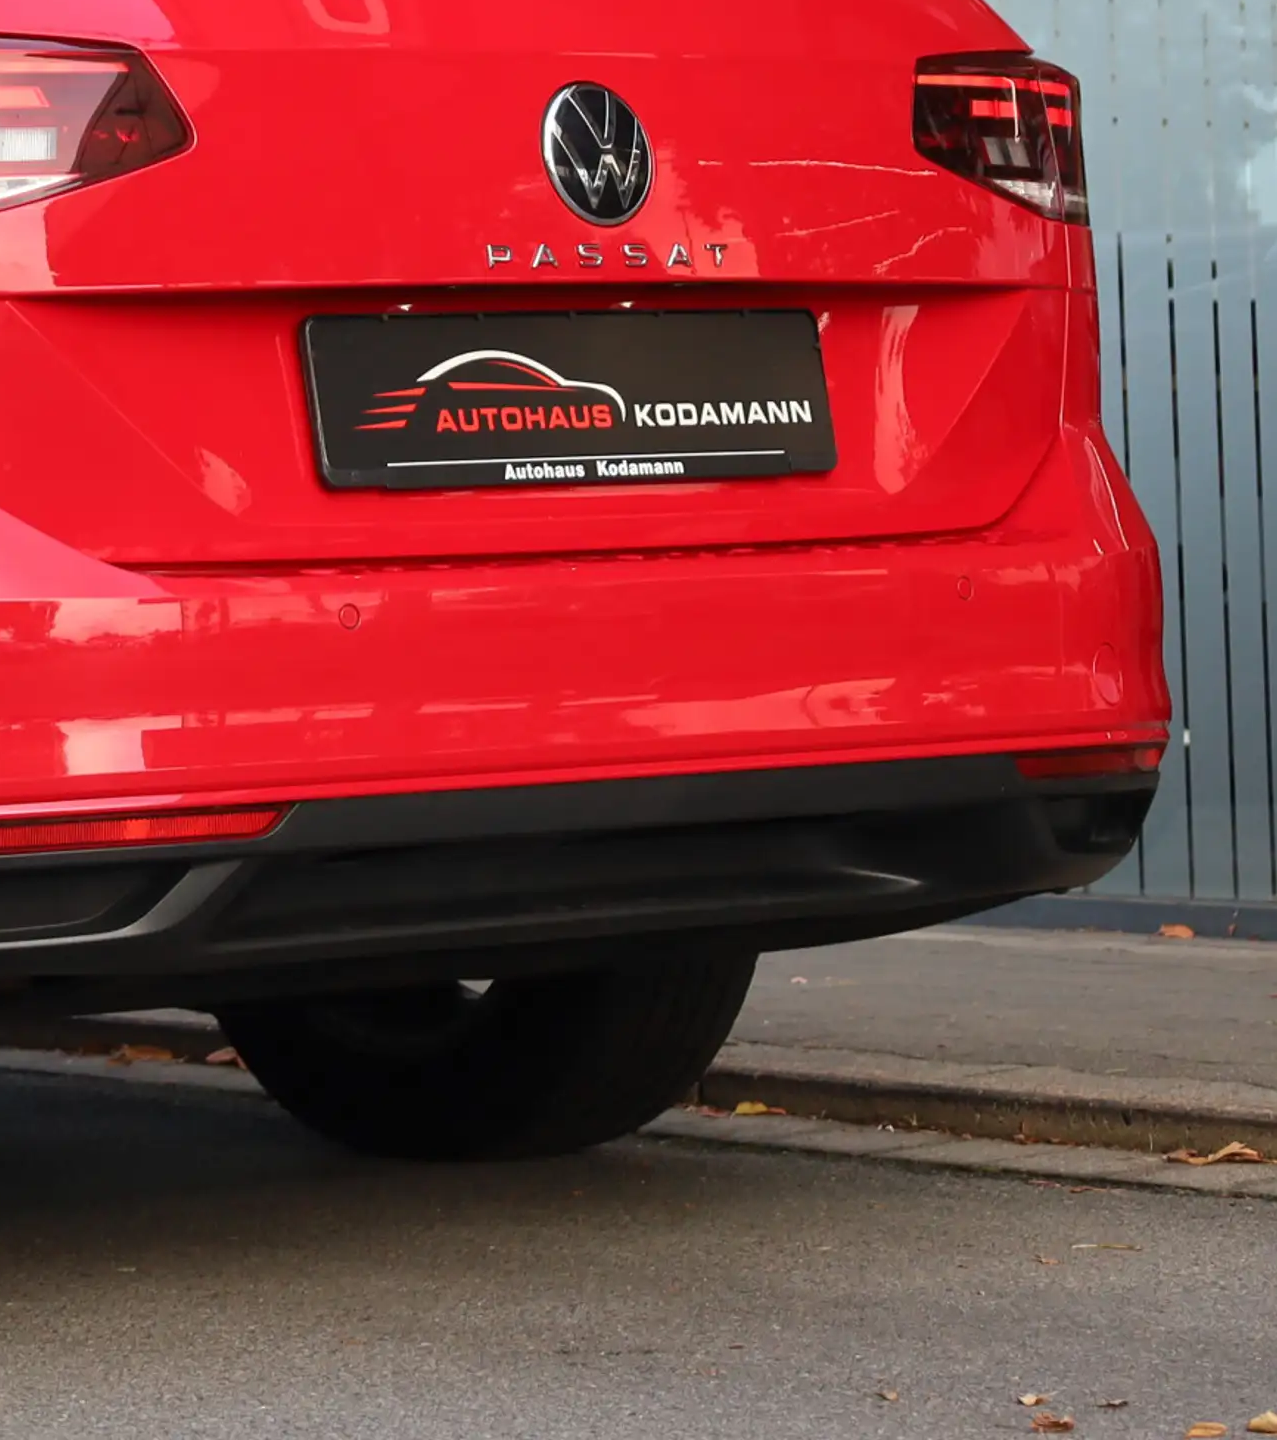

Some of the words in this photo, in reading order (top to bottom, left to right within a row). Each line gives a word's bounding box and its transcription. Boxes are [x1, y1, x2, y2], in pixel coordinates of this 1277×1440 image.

[486, 243, 729, 269] PASSAT
[436, 404, 613, 433] AUTOHAUS
[634, 400, 812, 427] KODAMANN
[504, 462, 586, 481] Autohaus
[596, 458, 685, 478] Kodamann
